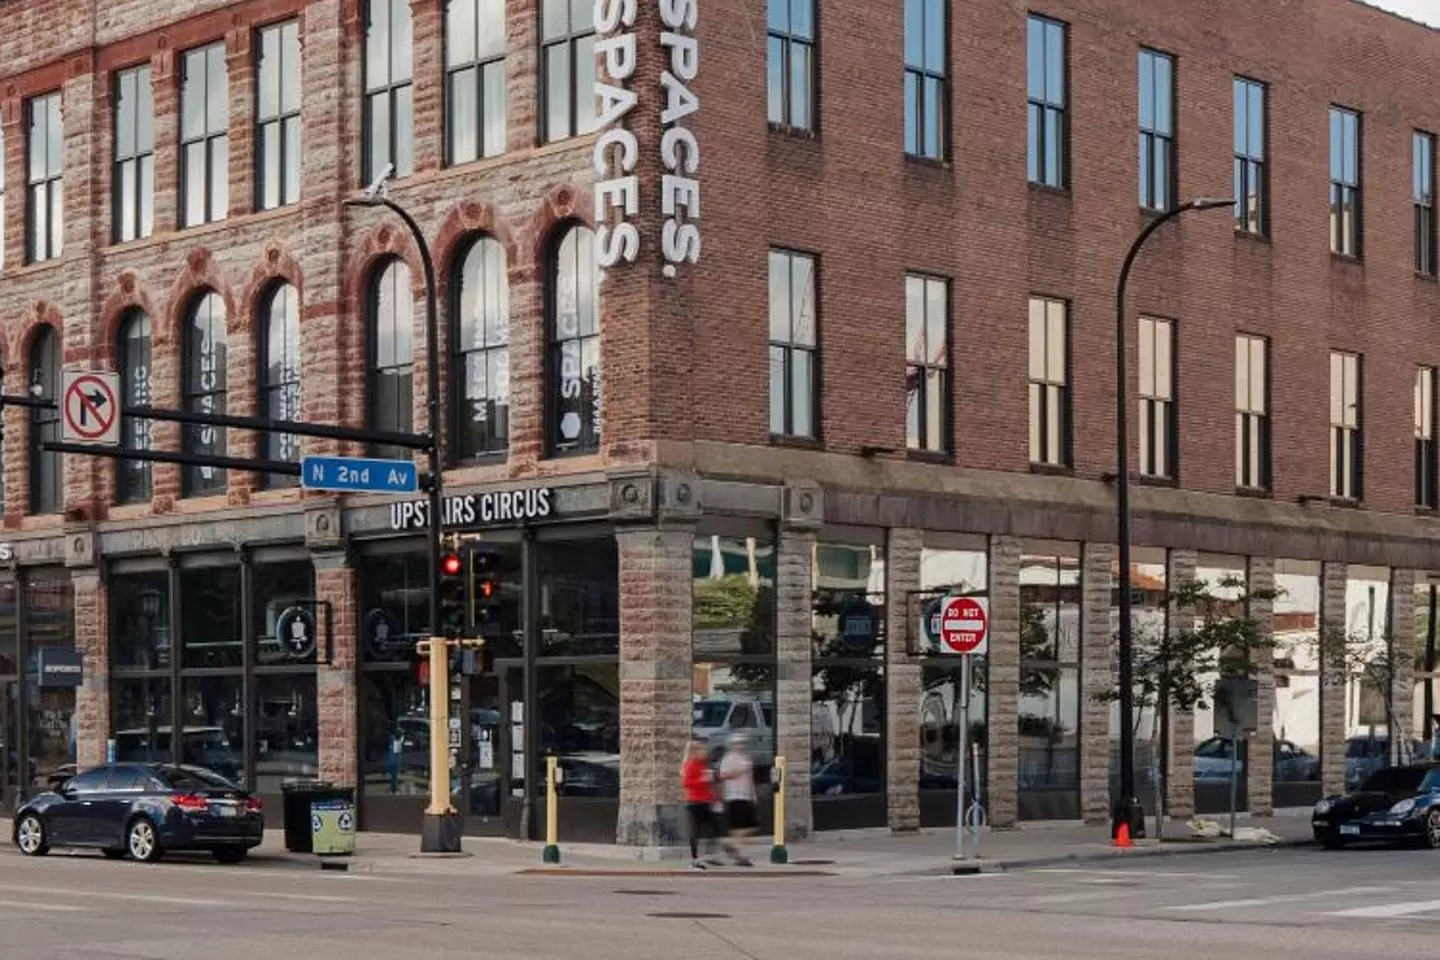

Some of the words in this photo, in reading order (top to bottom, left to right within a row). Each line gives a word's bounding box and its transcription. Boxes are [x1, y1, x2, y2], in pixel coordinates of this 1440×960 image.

[312, 464, 324, 482] N
[337, 465, 370, 484] 2nd
[386, 469, 409, 486] Av
[390, 495, 476, 529] UPSTIRS
[481, 488, 551, 522] CIRCUS
[948, 608, 959, 617] DO
[963, 608, 979, 617] NOT
[950, 633, 977, 643] ENTER
